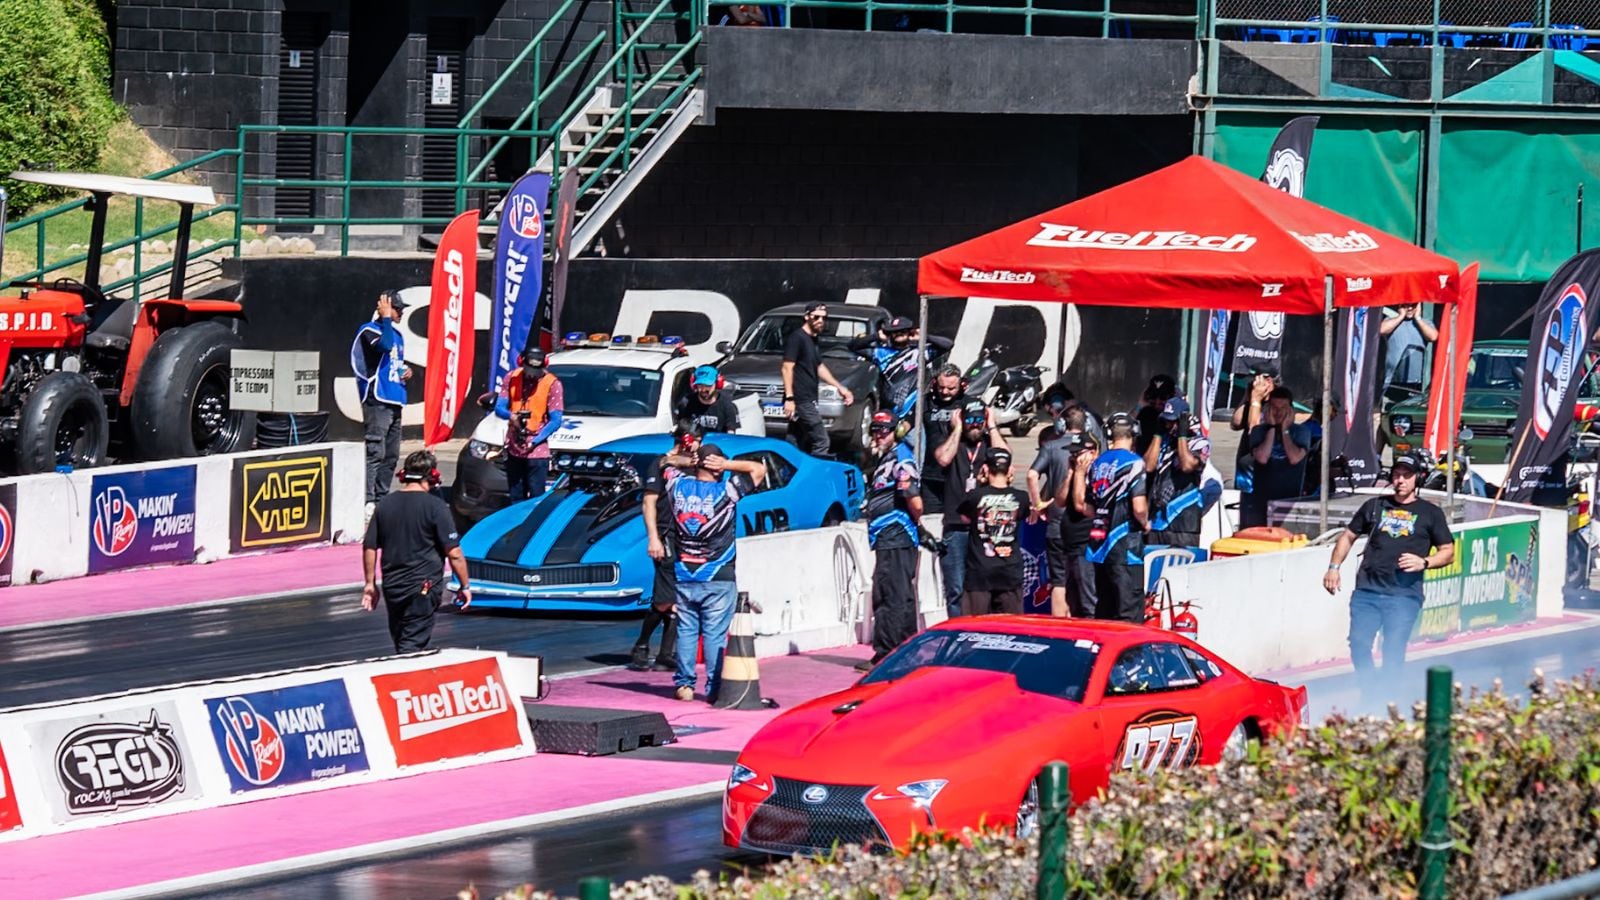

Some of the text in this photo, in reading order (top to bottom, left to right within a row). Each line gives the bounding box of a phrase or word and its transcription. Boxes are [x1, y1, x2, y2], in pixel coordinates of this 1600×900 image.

[1026, 222, 1257, 252] FuelTech
[960, 267, 1036, 284] FuelTech
[499, 241, 529, 371] POWER!
[440, 249, 463, 430] FuelTech
[234, 383, 268, 394] DE TEMPO
[95, 486, 127, 554] VP
[138, 493, 178, 519] MAKIN'
[152, 513, 195, 538] POWER!
[274, 703, 325, 735] MAKIN'
[390, 675, 508, 736] FuelTech
[216, 697, 263, 781] VP
[305, 728, 361, 760] POWER!
[71, 735, 171, 790] REGIS
